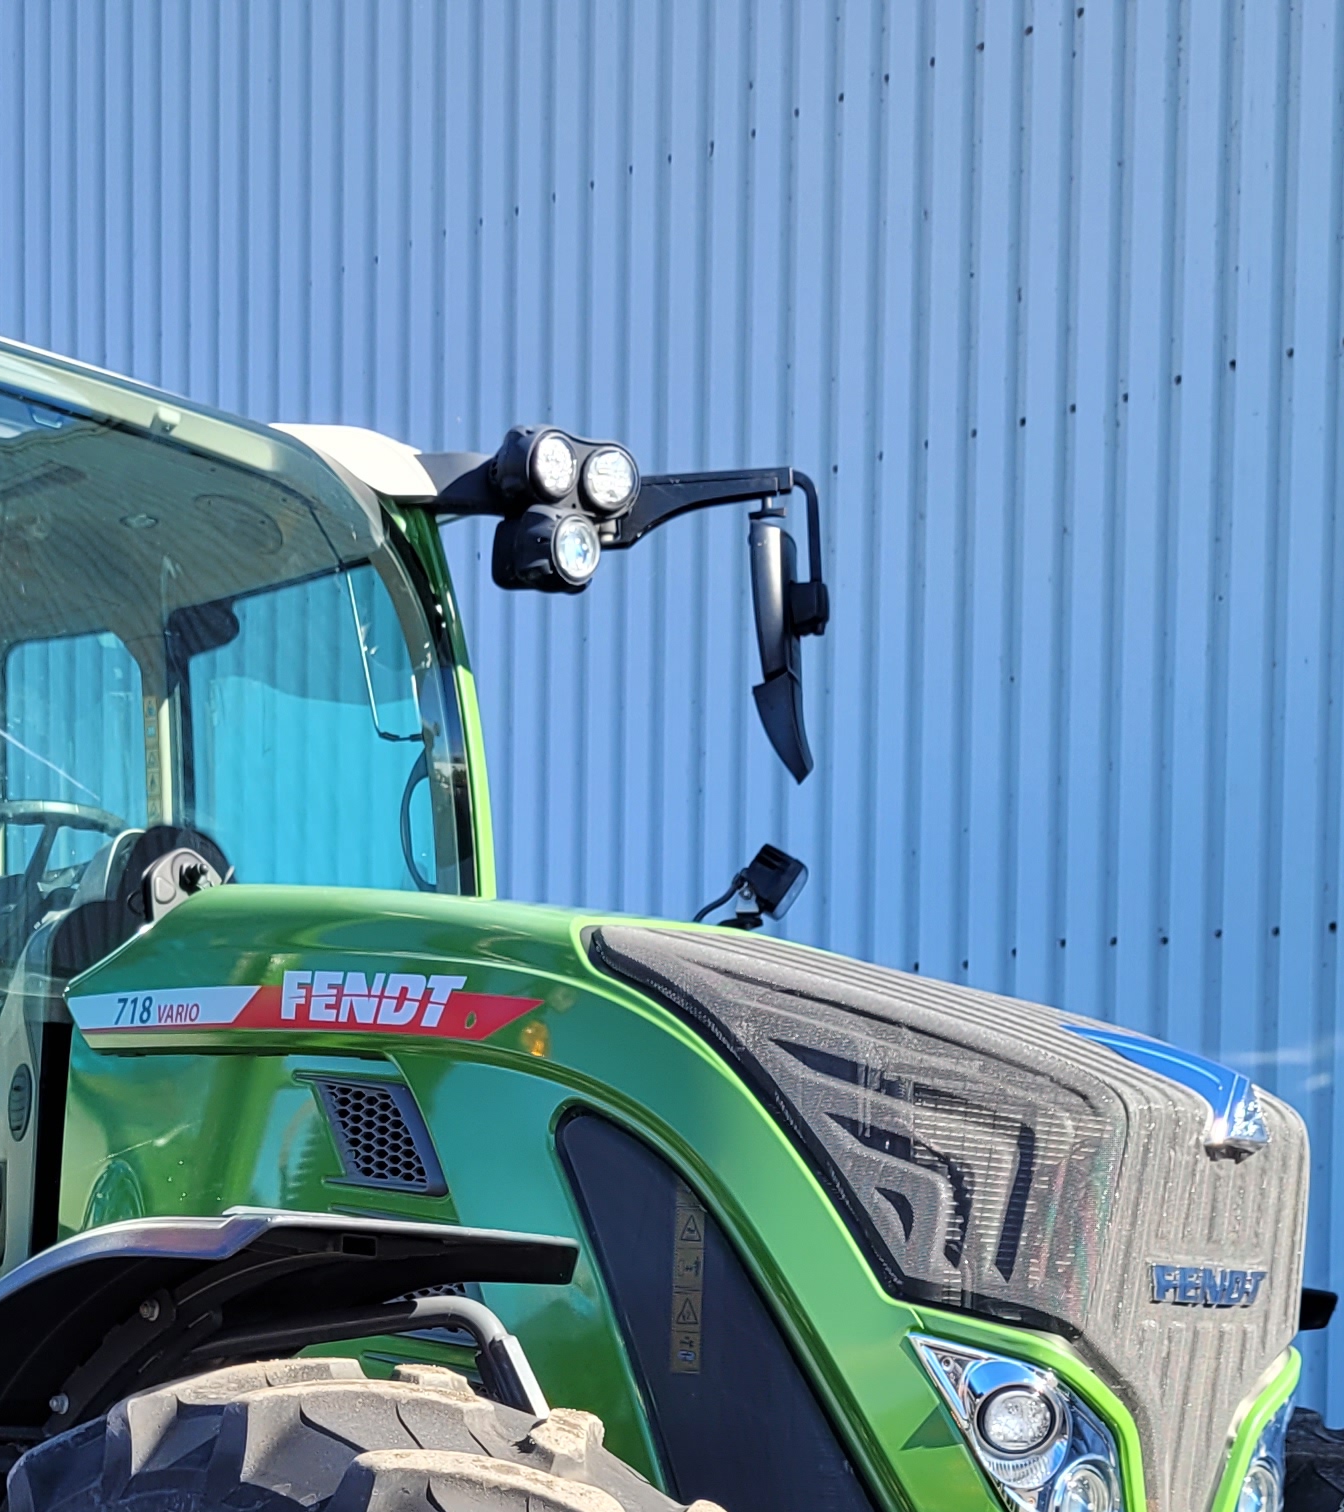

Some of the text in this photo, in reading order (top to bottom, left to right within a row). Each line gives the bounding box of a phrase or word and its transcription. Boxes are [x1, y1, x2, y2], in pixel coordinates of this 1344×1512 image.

[113, 996, 200, 1025] 718 VARIO
[281, 970, 467, 1028] FENDT
[1149, 1263, 1268, 1309] FENDT
